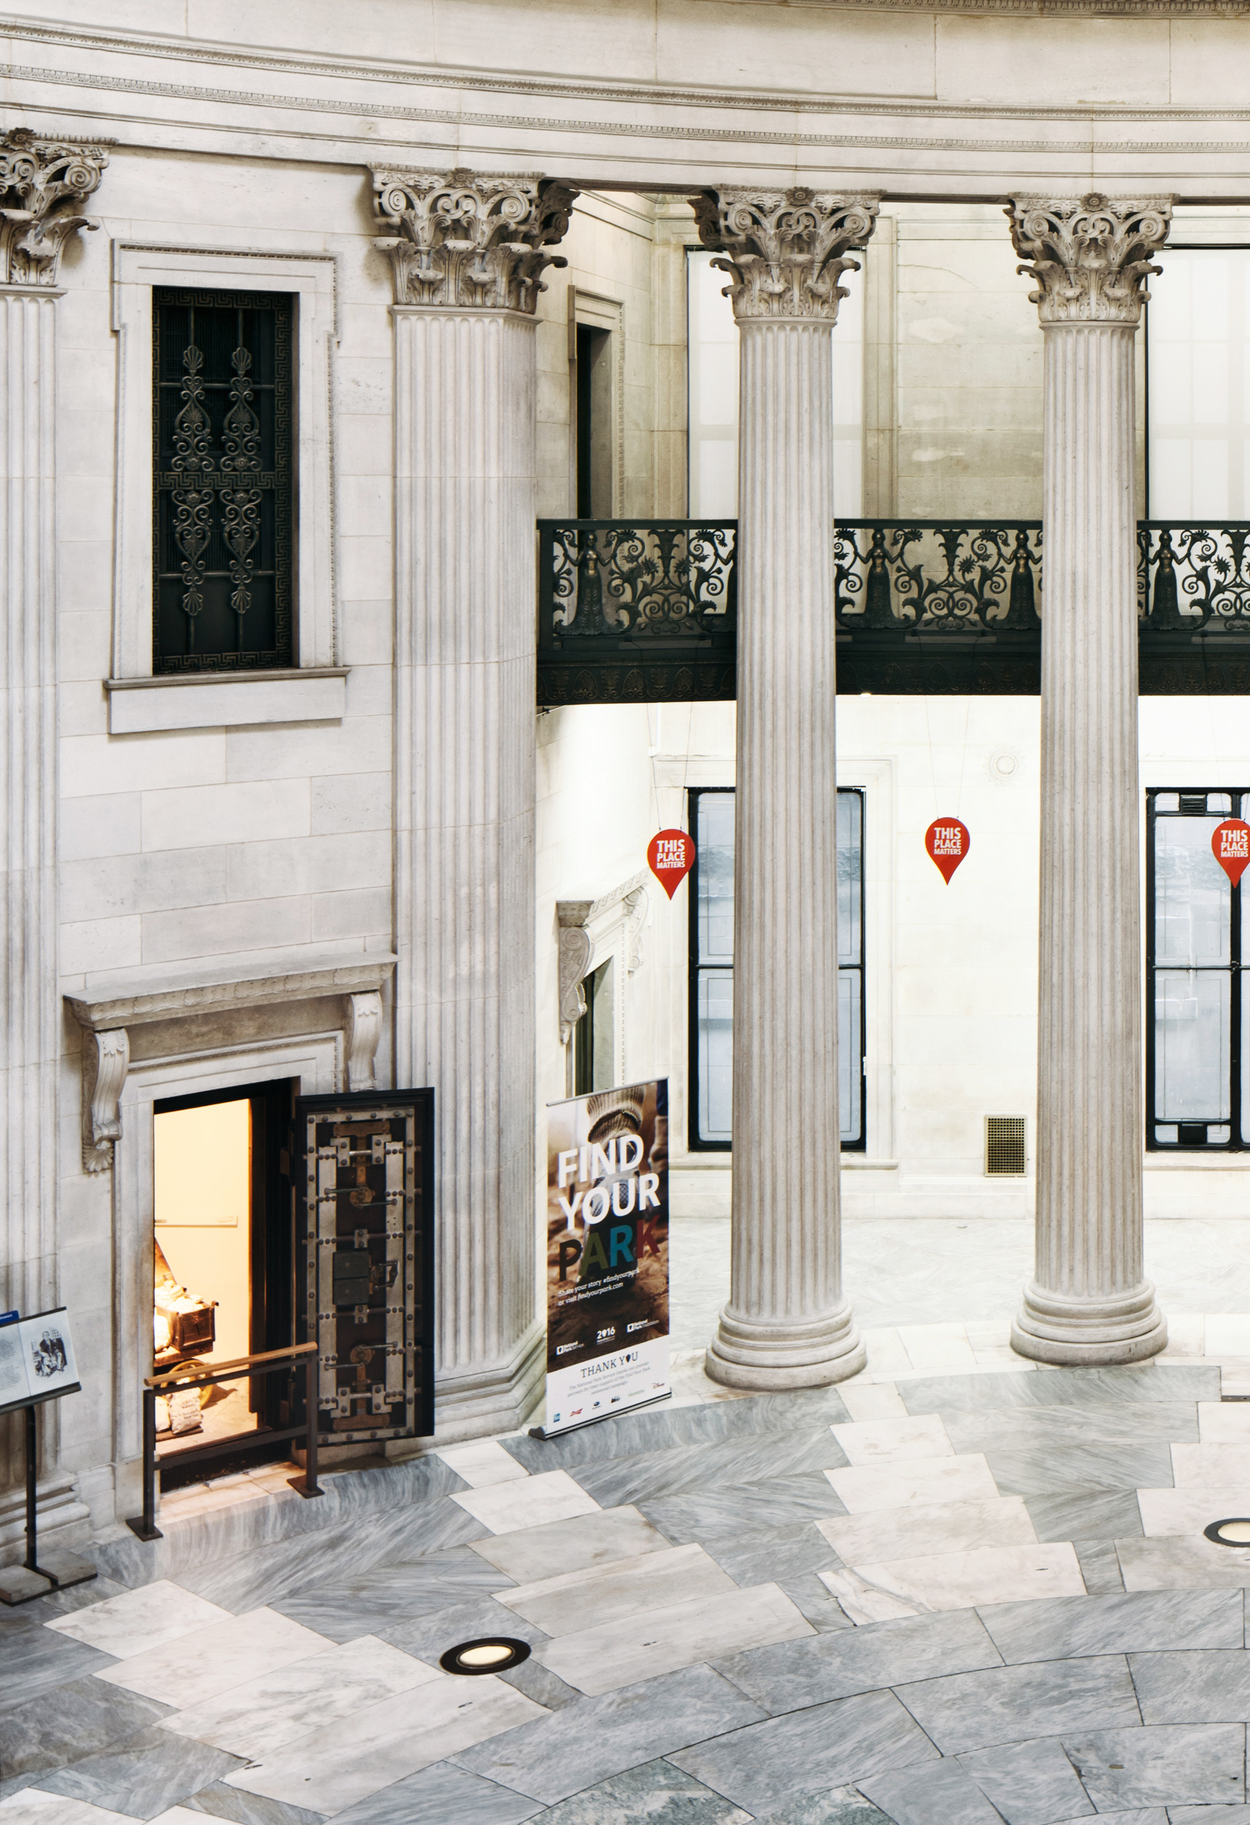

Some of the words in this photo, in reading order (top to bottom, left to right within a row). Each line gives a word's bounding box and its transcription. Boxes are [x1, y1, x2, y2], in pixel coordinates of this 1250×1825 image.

[934, 827, 961, 840] THIS
[1220, 829, 1248, 842] THIS
[657, 838, 685, 854] THIS
[934, 839, 961, 849] PLACE
[1220, 841, 1248, 851] PLACE
[657, 851, 685, 862] PLACE
[1220, 849, 1248, 858] MATTERS
[657, 860, 685, 869] MATTERS
[557, 1134, 645, 1189] FIND
[558, 1172, 661, 1231] YOUR
[558, 1214, 661, 1283] PARK
[558, 1288, 574, 1297] Share
[575, 1283, 587, 1293] your
[588, 1279, 602, 1288] story
[580, 1358, 617, 1378] THANK
